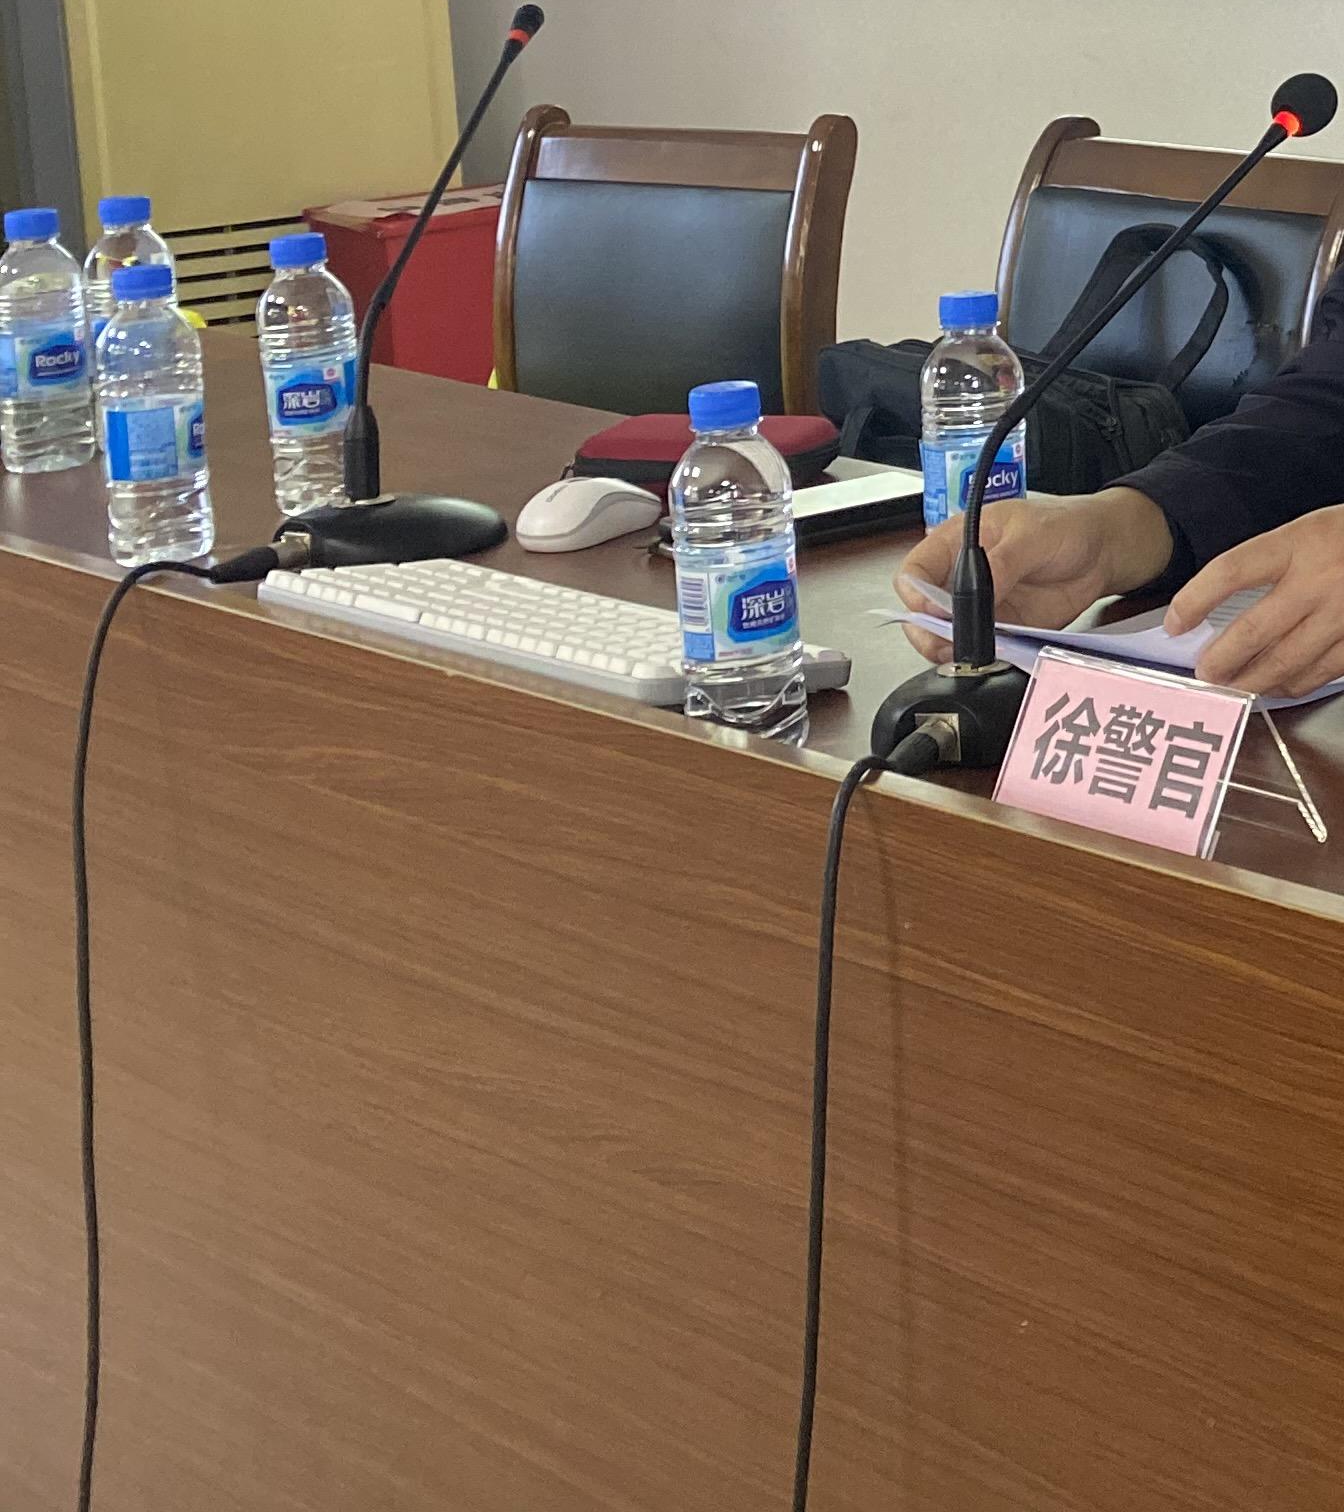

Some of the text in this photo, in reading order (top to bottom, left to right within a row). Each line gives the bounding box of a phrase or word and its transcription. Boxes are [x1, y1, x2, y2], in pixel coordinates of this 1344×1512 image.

[36, 348, 81, 368] Rocky
[741, 588, 785, 621] 深岩
[1030, 692, 1225, 820] 徐警官
